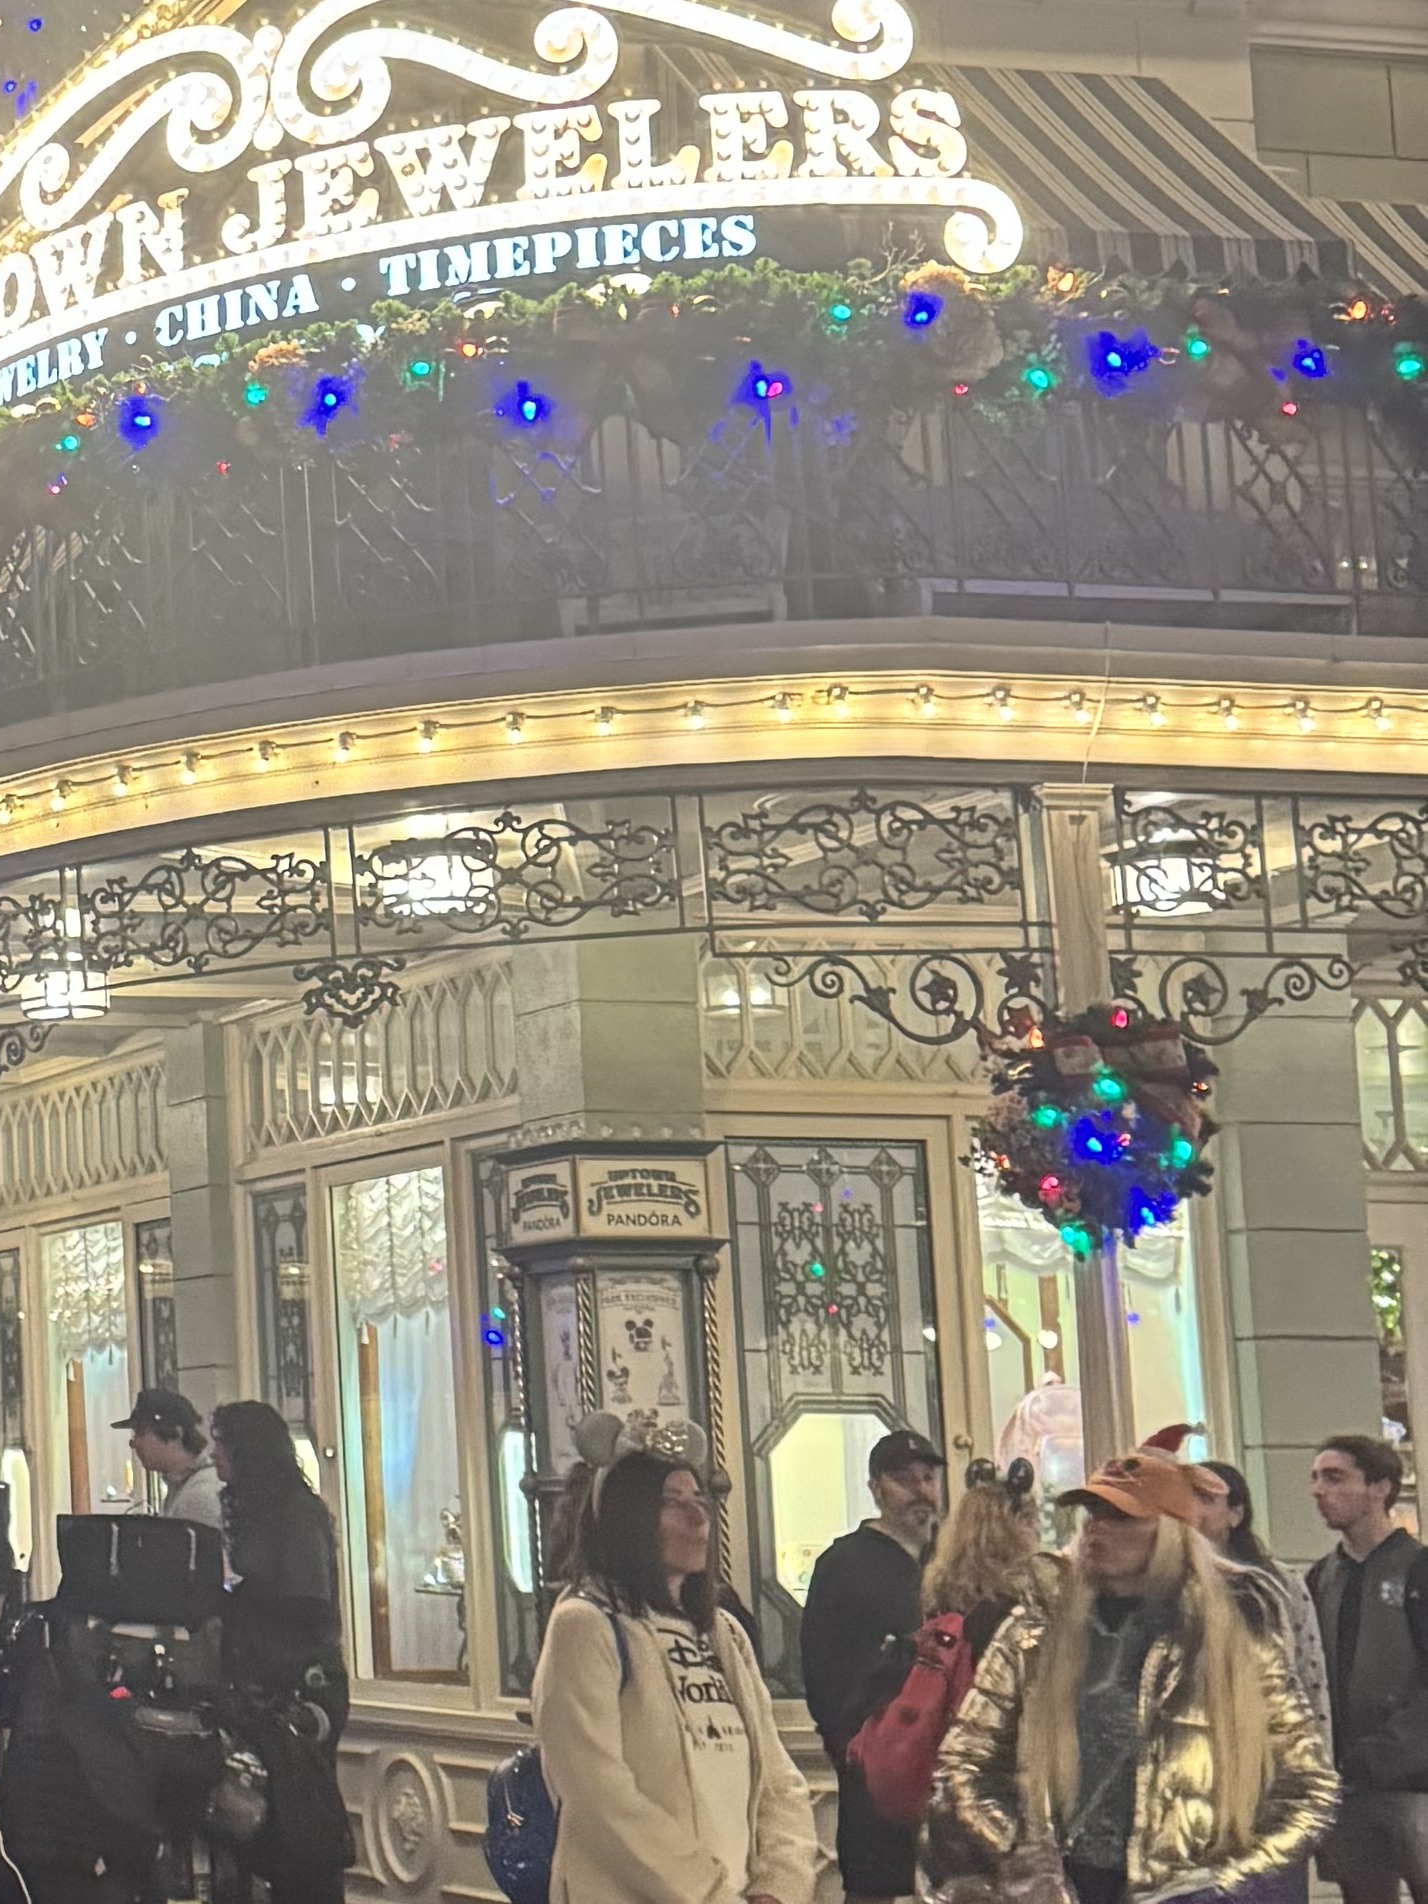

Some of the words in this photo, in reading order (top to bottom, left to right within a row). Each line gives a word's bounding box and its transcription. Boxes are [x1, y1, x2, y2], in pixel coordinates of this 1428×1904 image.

[221, 88, 969, 254] JEWELERS
[155, 273, 319, 347] CHINA
[379, 213, 757, 298] TIMEPIECES
[587, 1182, 701, 1219] JEWELERS
